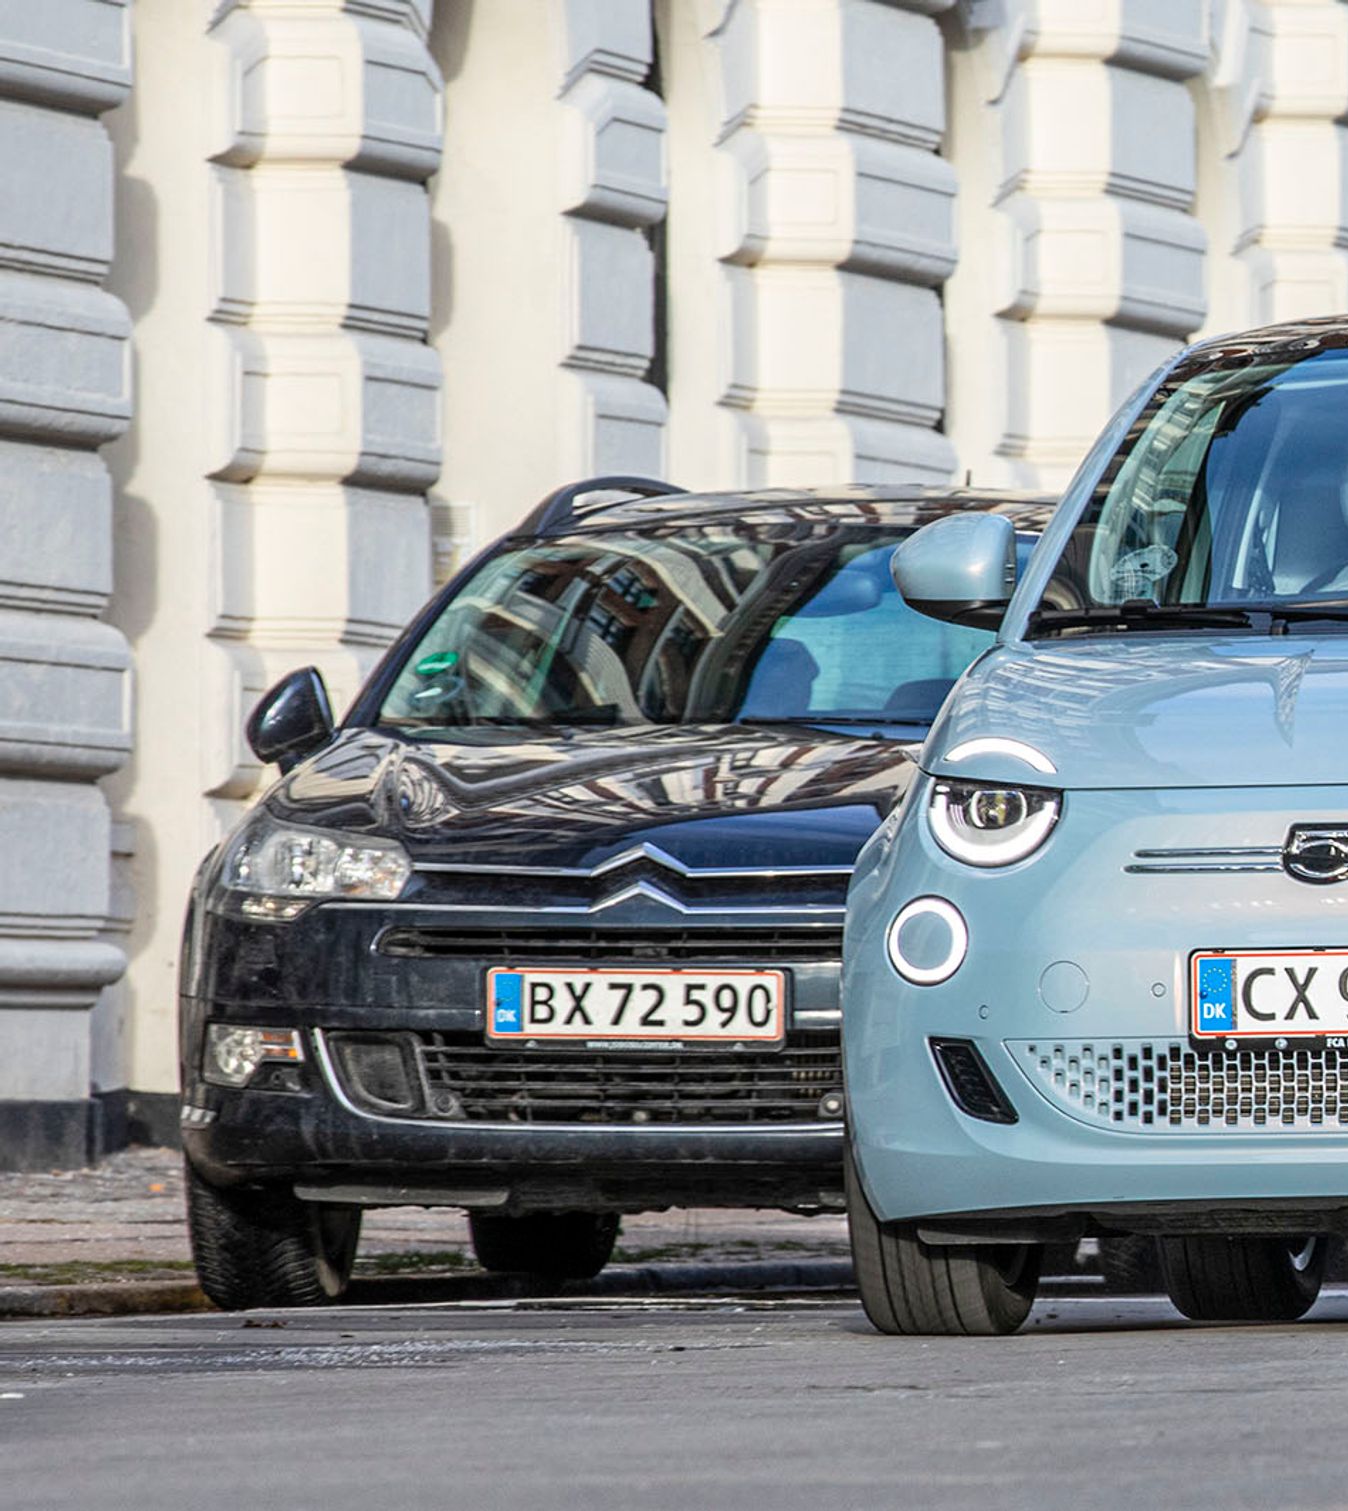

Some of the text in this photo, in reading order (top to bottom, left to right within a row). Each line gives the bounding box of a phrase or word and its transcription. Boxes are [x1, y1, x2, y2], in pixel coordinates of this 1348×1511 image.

[1241, 966, 1320, 1021] CX
[529, 981, 772, 1028] BX 72 590
[1203, 1003, 1227, 1019] DK
[497, 1010, 516, 1023] DK
[1326, 1038, 1345, 1048] FCA
